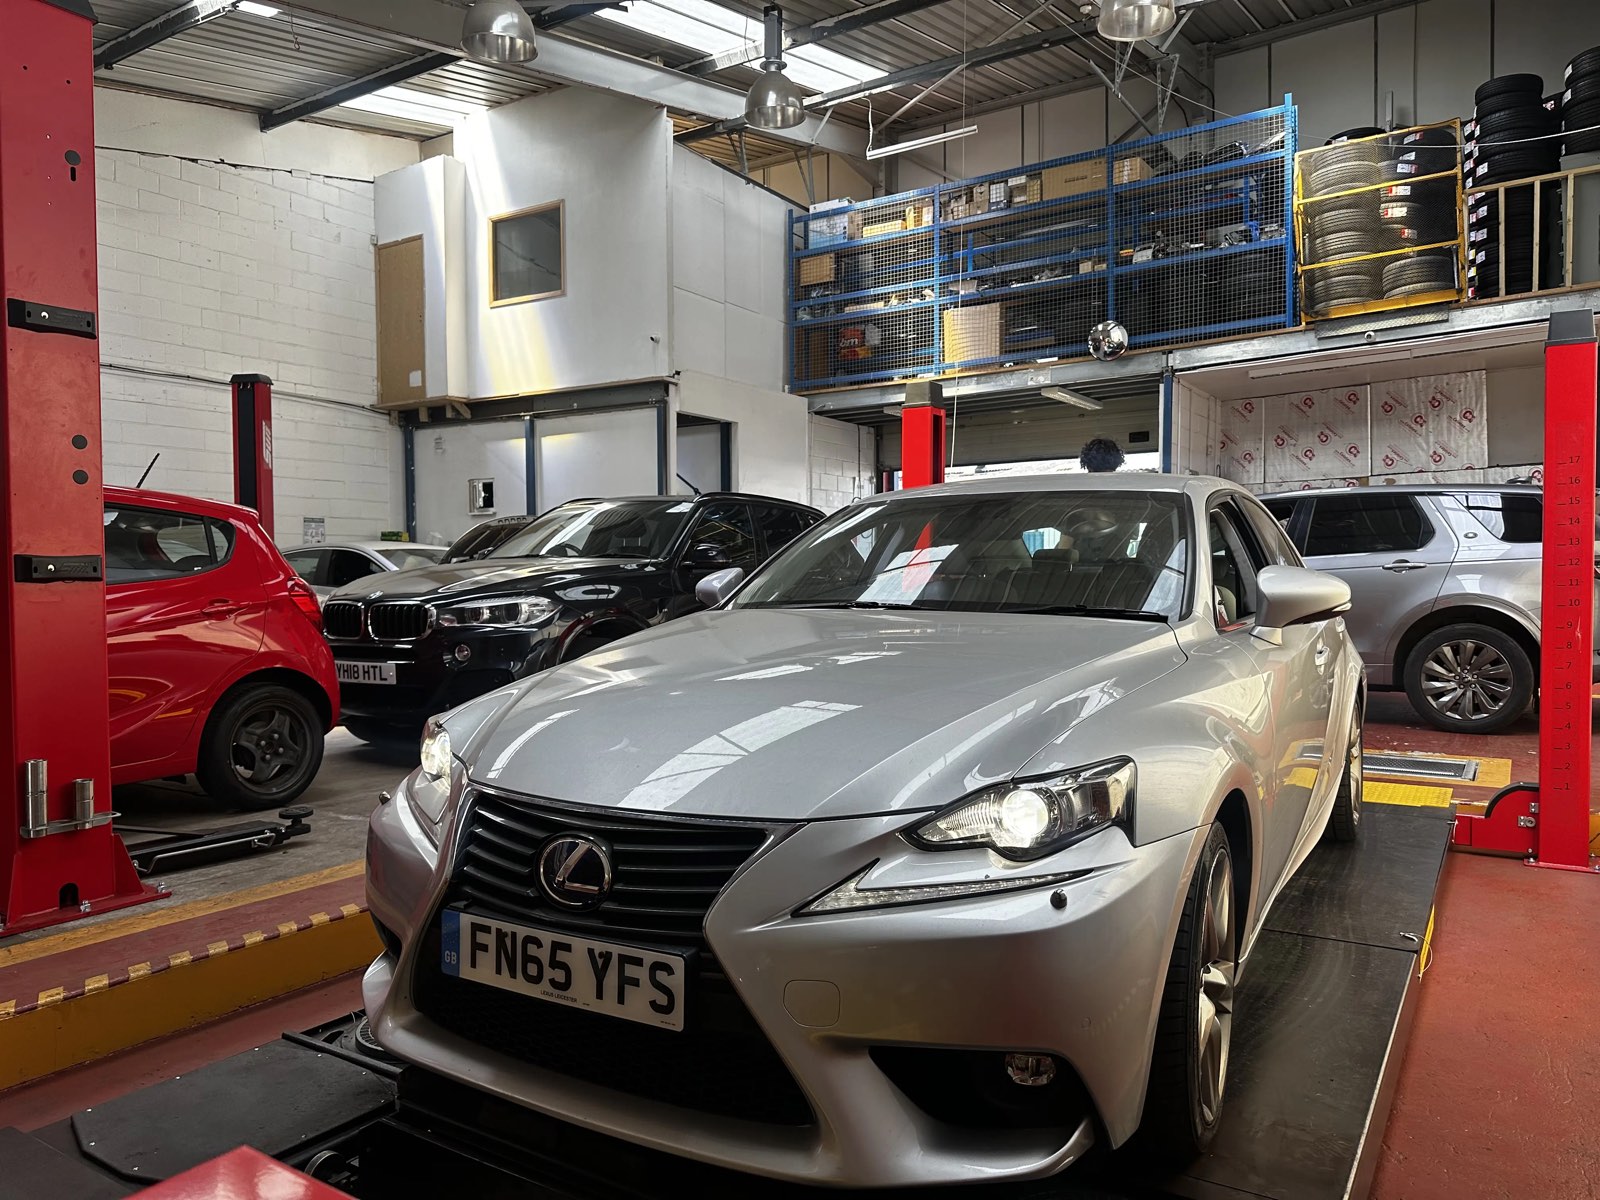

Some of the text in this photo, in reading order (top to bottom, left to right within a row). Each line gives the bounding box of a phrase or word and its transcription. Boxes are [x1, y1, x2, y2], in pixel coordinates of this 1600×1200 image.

[1569, 456, 1580, 464] 17
[1569, 477, 1580, 485] 16
[1569, 497, 1580, 505] 15
[1569, 517, 1580, 525] 14
[1569, 538, 1580, 546] 13
[1569, 558, 1580, 566] 12
[1569, 579, 1579, 587] 11
[1569, 599, 1580, 608] 10
[336, 663, 388, 681] YH18 HTL
[1565, 722, 1571, 730] 4
[444, 951, 457, 964] GB
[470, 921, 675, 1015] FN65 YFS
[540, 989, 554, 998] LEXUS
[555, 993, 578, 1004] LEICESTER
